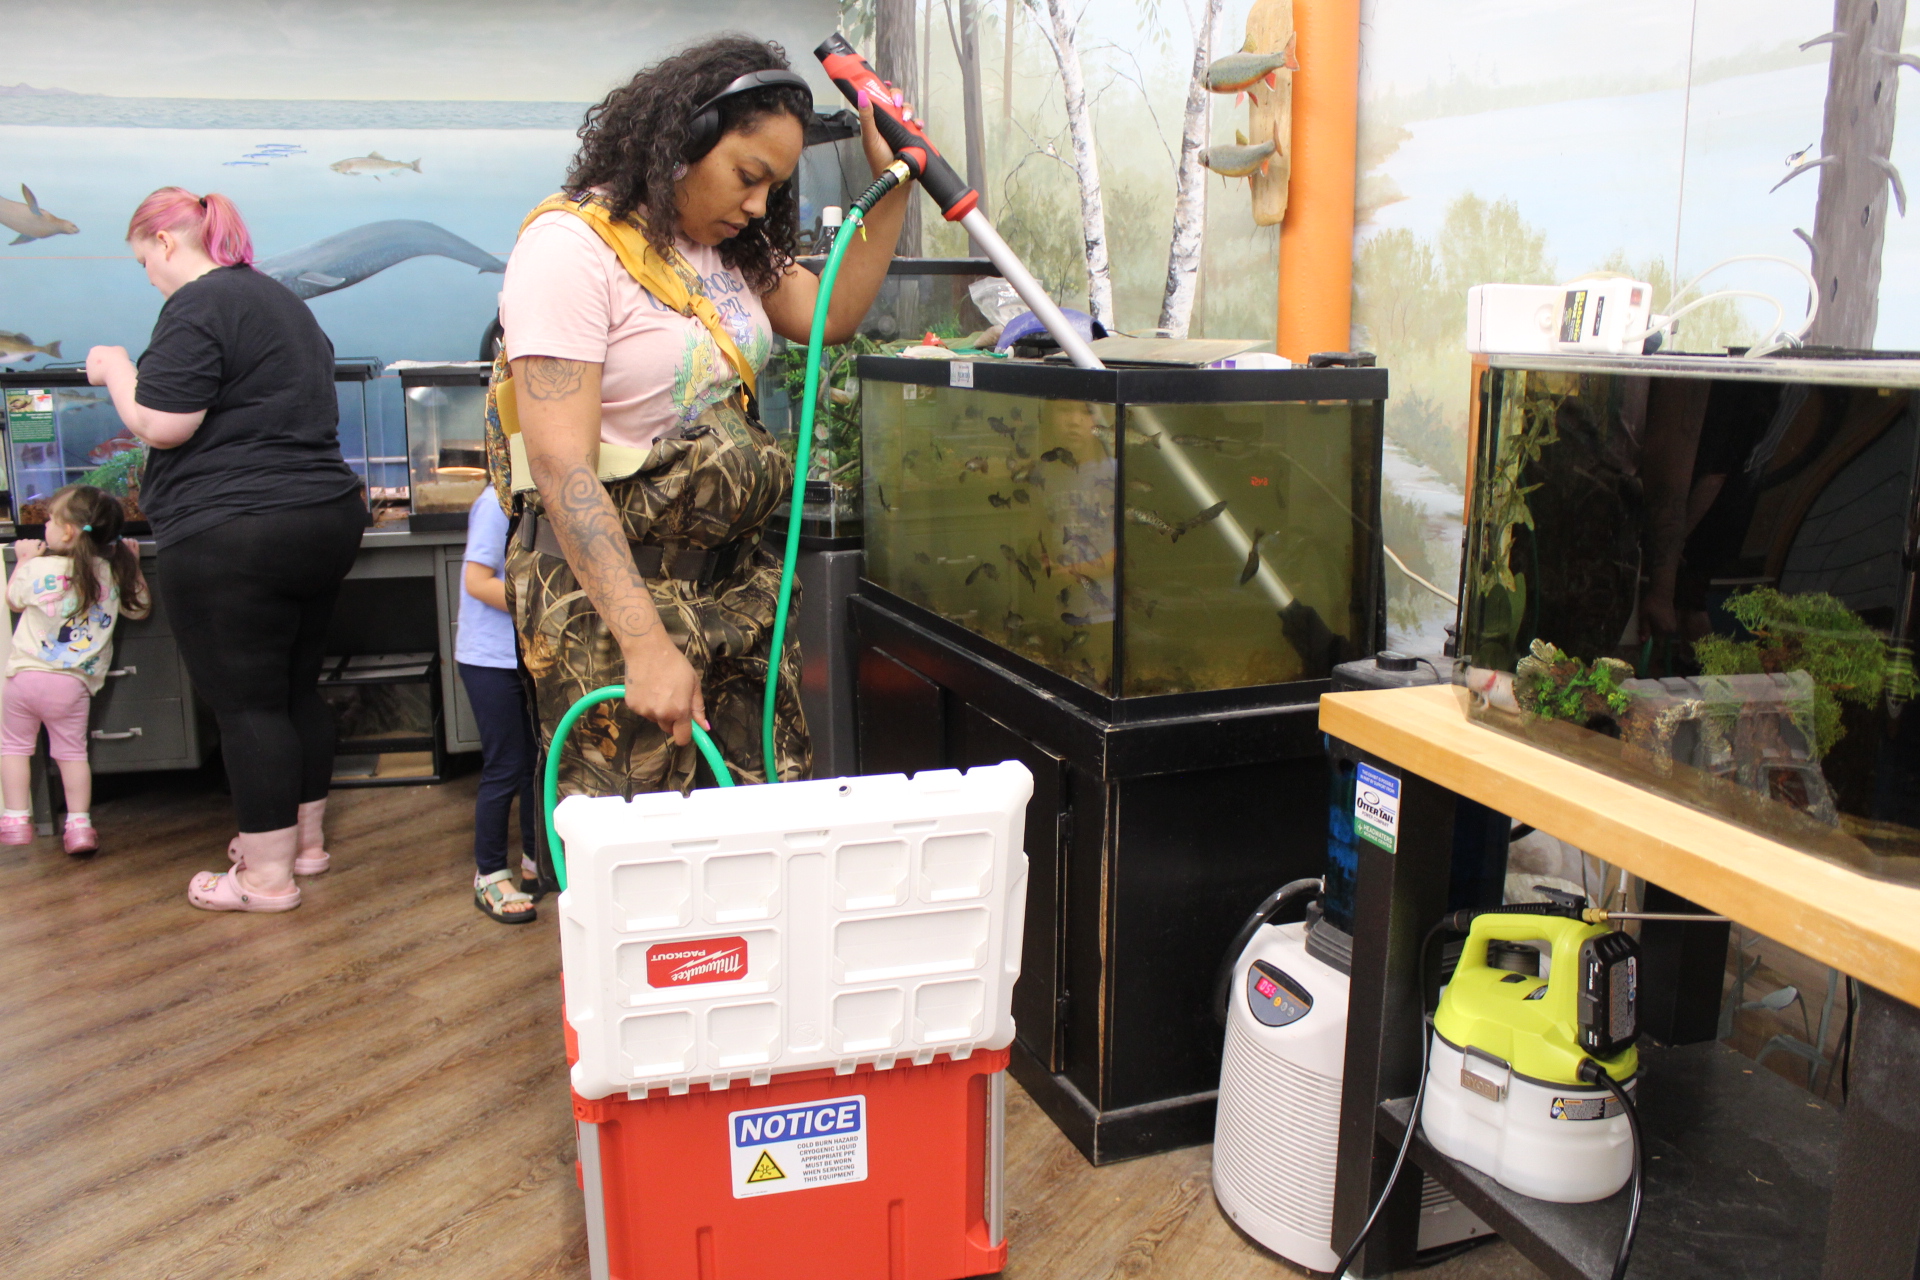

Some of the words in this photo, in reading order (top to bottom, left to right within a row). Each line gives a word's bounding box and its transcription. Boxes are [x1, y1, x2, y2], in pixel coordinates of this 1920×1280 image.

[1573, 291, 1586, 341] Bubble
[1357, 797, 1379, 816] OTTER
[1379, 808, 1394, 824] TAIL
[1363, 823, 1393, 844] HEADWATERS
[650, 949, 706, 961] PACKOUT
[671, 953, 744, 982] Milwaukee
[740, 1104, 857, 1143] NOTICE
[797, 1142, 814, 1150] COLD
[815, 1139, 833, 1147] BURN
[834, 1135, 859, 1144] HAZARD
[799, 1146, 835, 1156] CRYOGENIC
[836, 1142, 857, 1151] LIQUID
[801, 1151, 843, 1163] APPROPRIATE
[834, 1157, 852, 1165] WORN
[802, 1168, 821, 1176] WHEN
[822, 1163, 855, 1174] SERVICING
[804, 1175, 818, 1183] THIS
[819, 1171, 855, 1181] EQUIPMENT
